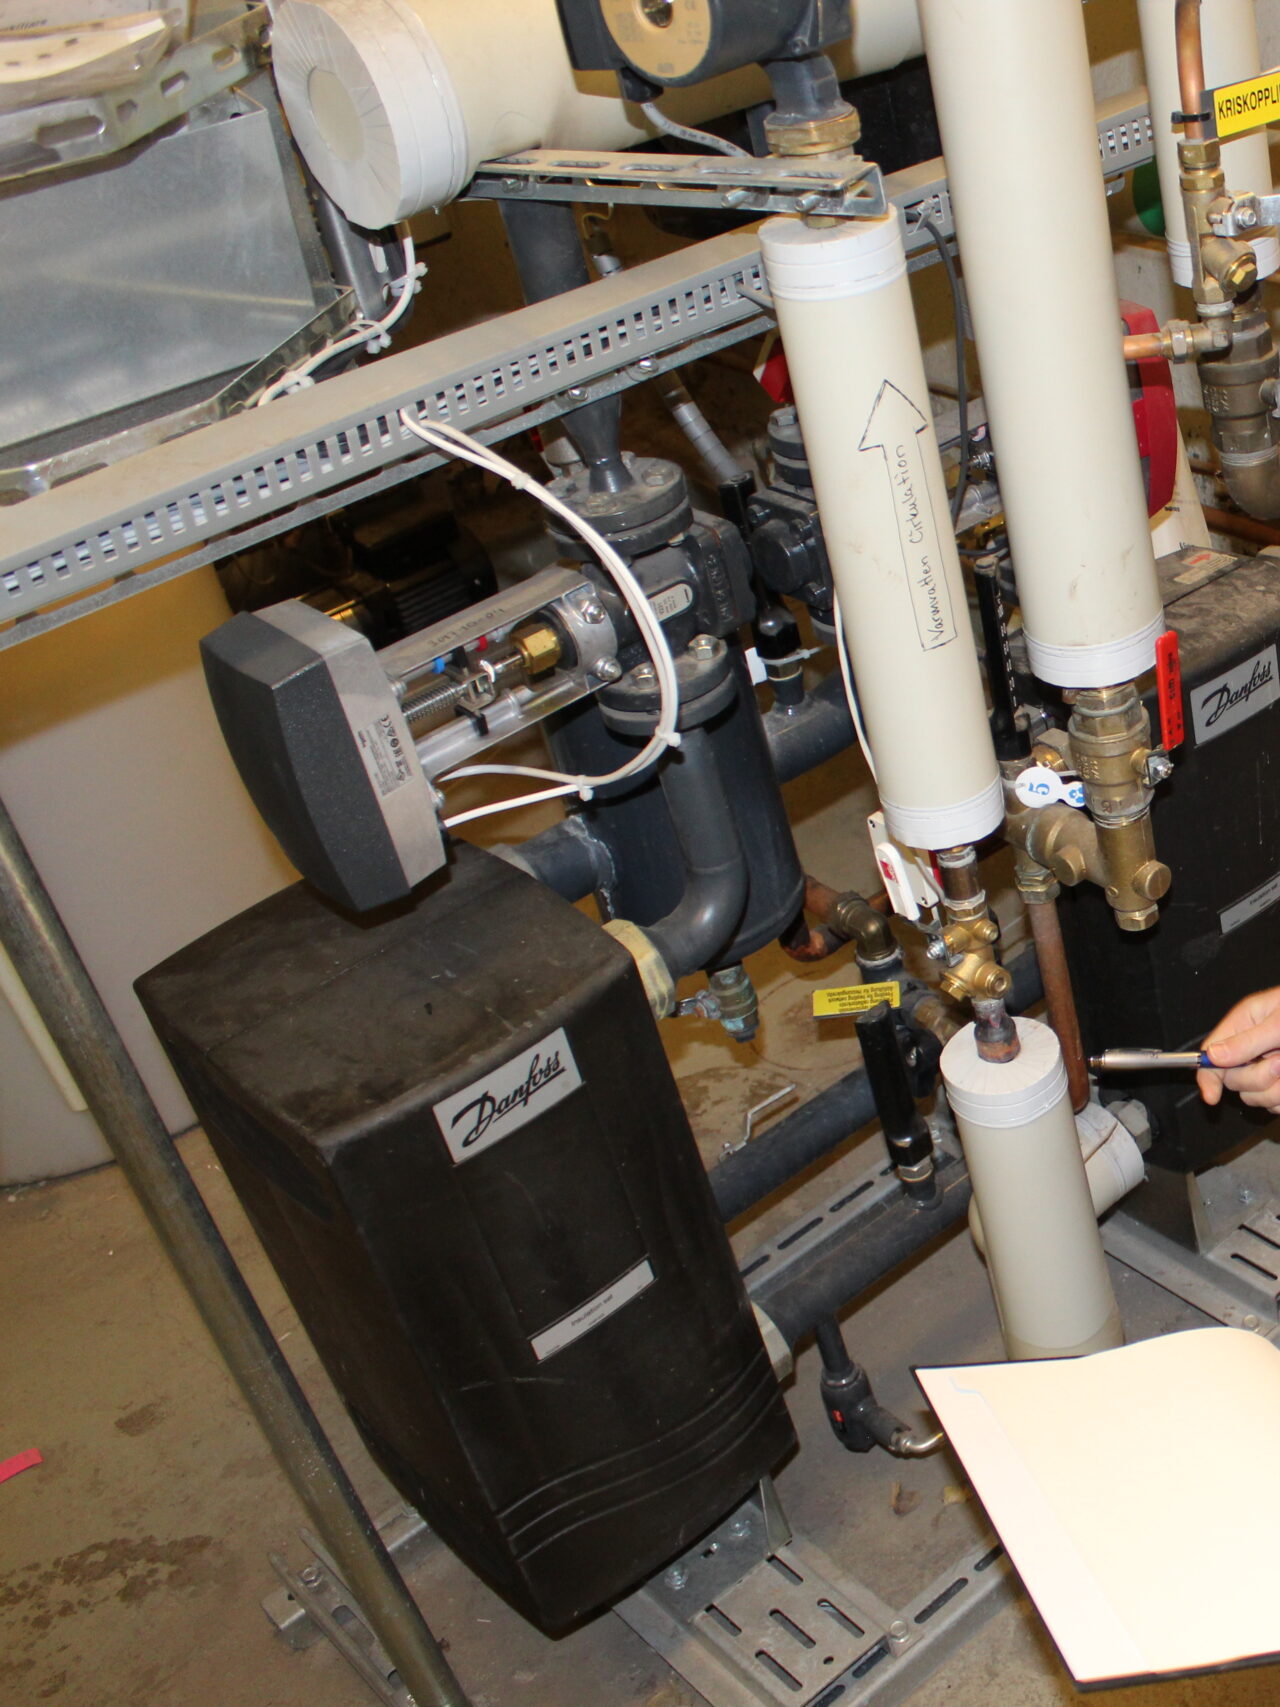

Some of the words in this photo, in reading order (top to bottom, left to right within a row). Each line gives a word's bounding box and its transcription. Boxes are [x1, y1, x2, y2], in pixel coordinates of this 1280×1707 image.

[894, 444, 924, 544] Cirkulation
[917, 554, 945, 642] Varmvatten
[1201, 660, 1274, 728] Danfoss
[1027, 782, 1050, 796] 5
[450, 1050, 567, 1148] Danfoss
